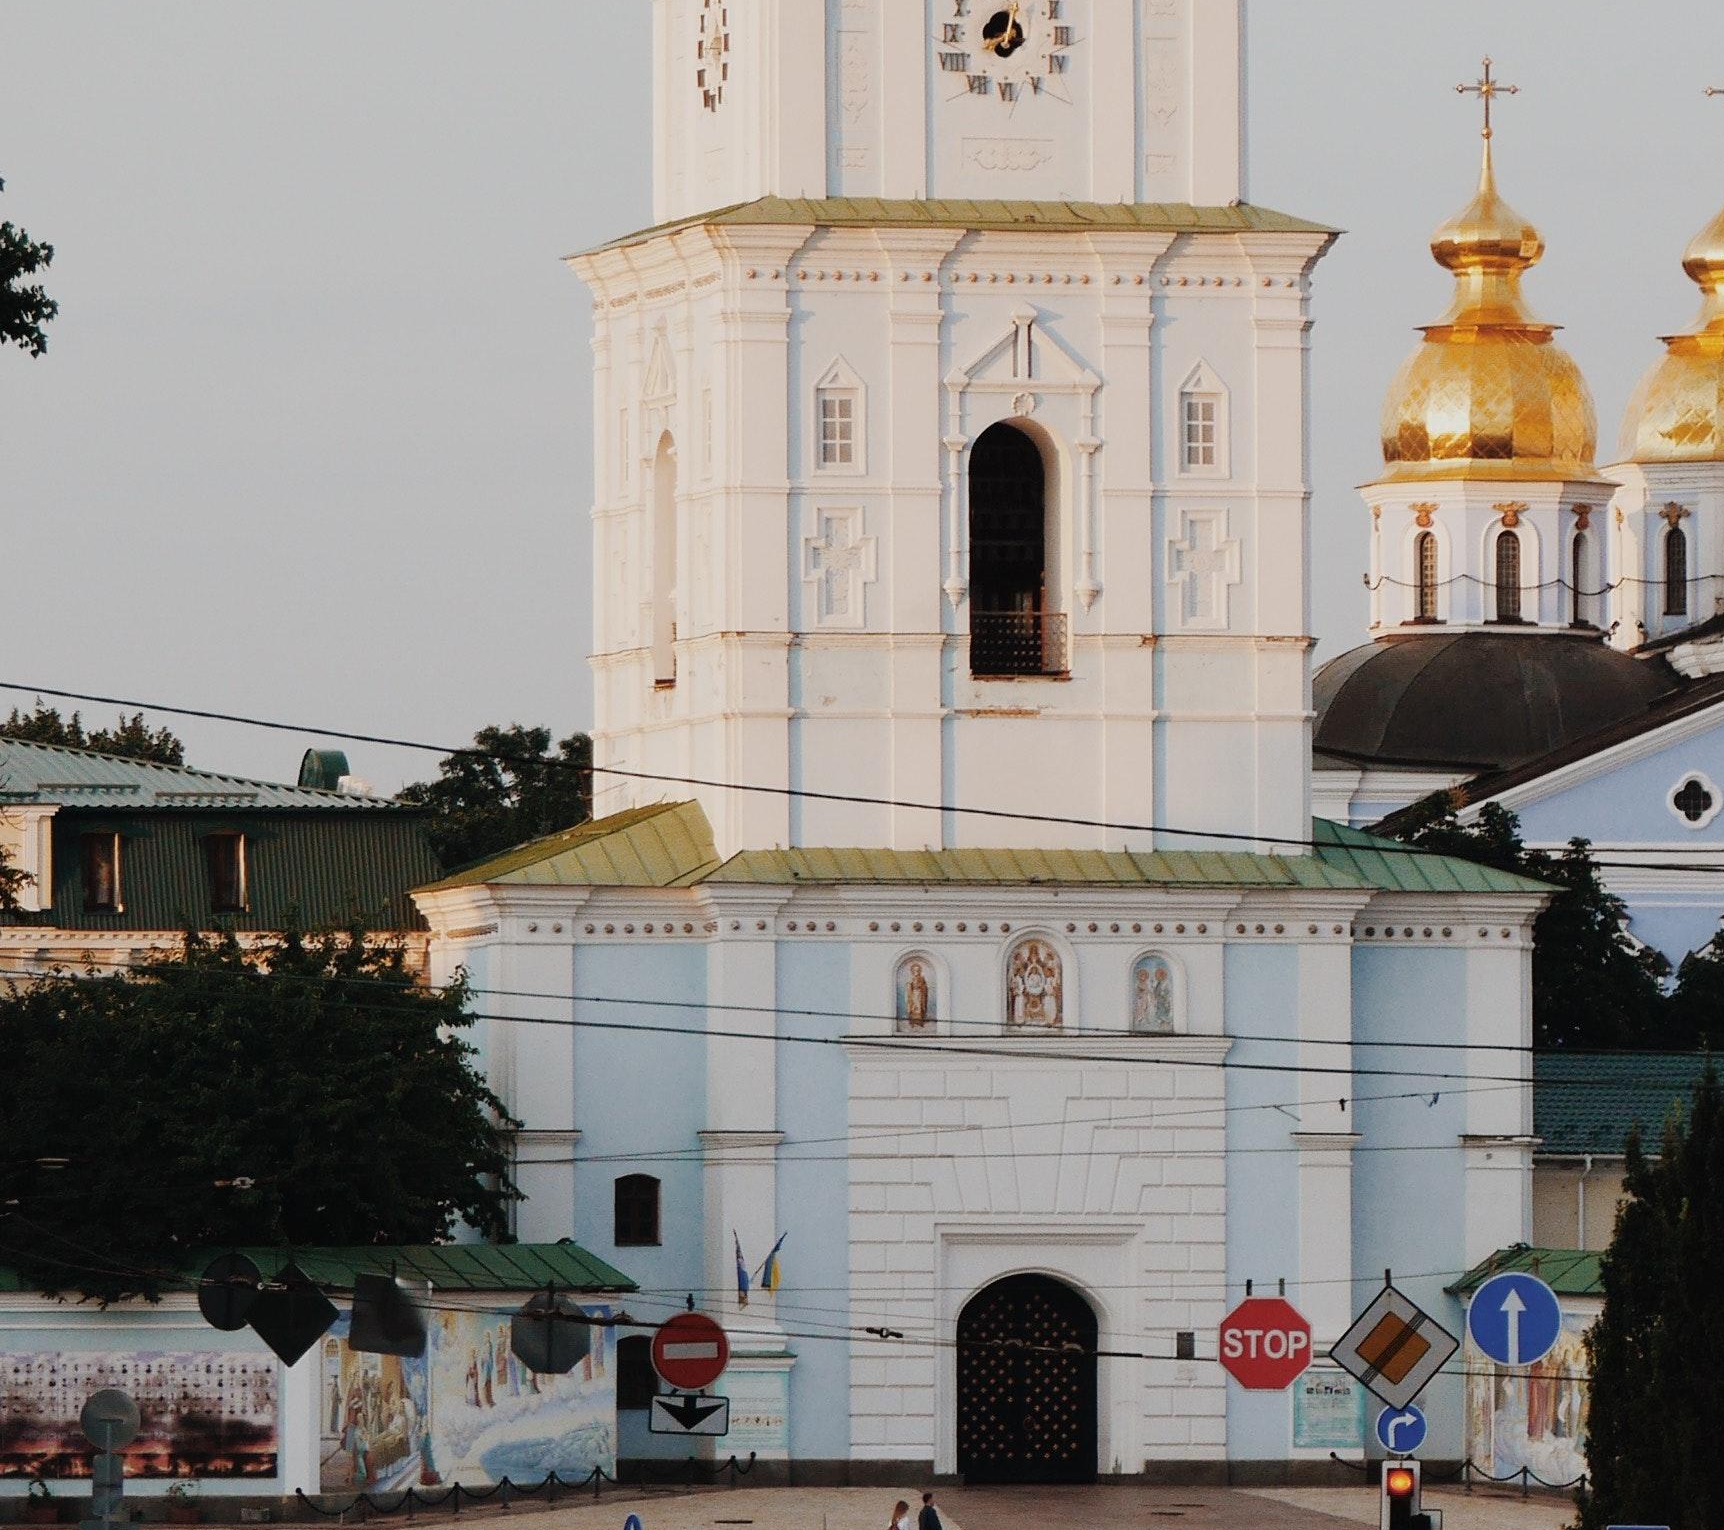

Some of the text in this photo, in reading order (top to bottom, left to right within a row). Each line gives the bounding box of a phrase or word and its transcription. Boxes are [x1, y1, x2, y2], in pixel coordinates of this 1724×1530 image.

[943, 23, 959, 42] IX
[1048, 54, 1065, 74] IV
[998, 82, 1013, 102] VI
[1030, 76, 1041, 95] V
[1223, 1328, 1308, 1359] STOP
